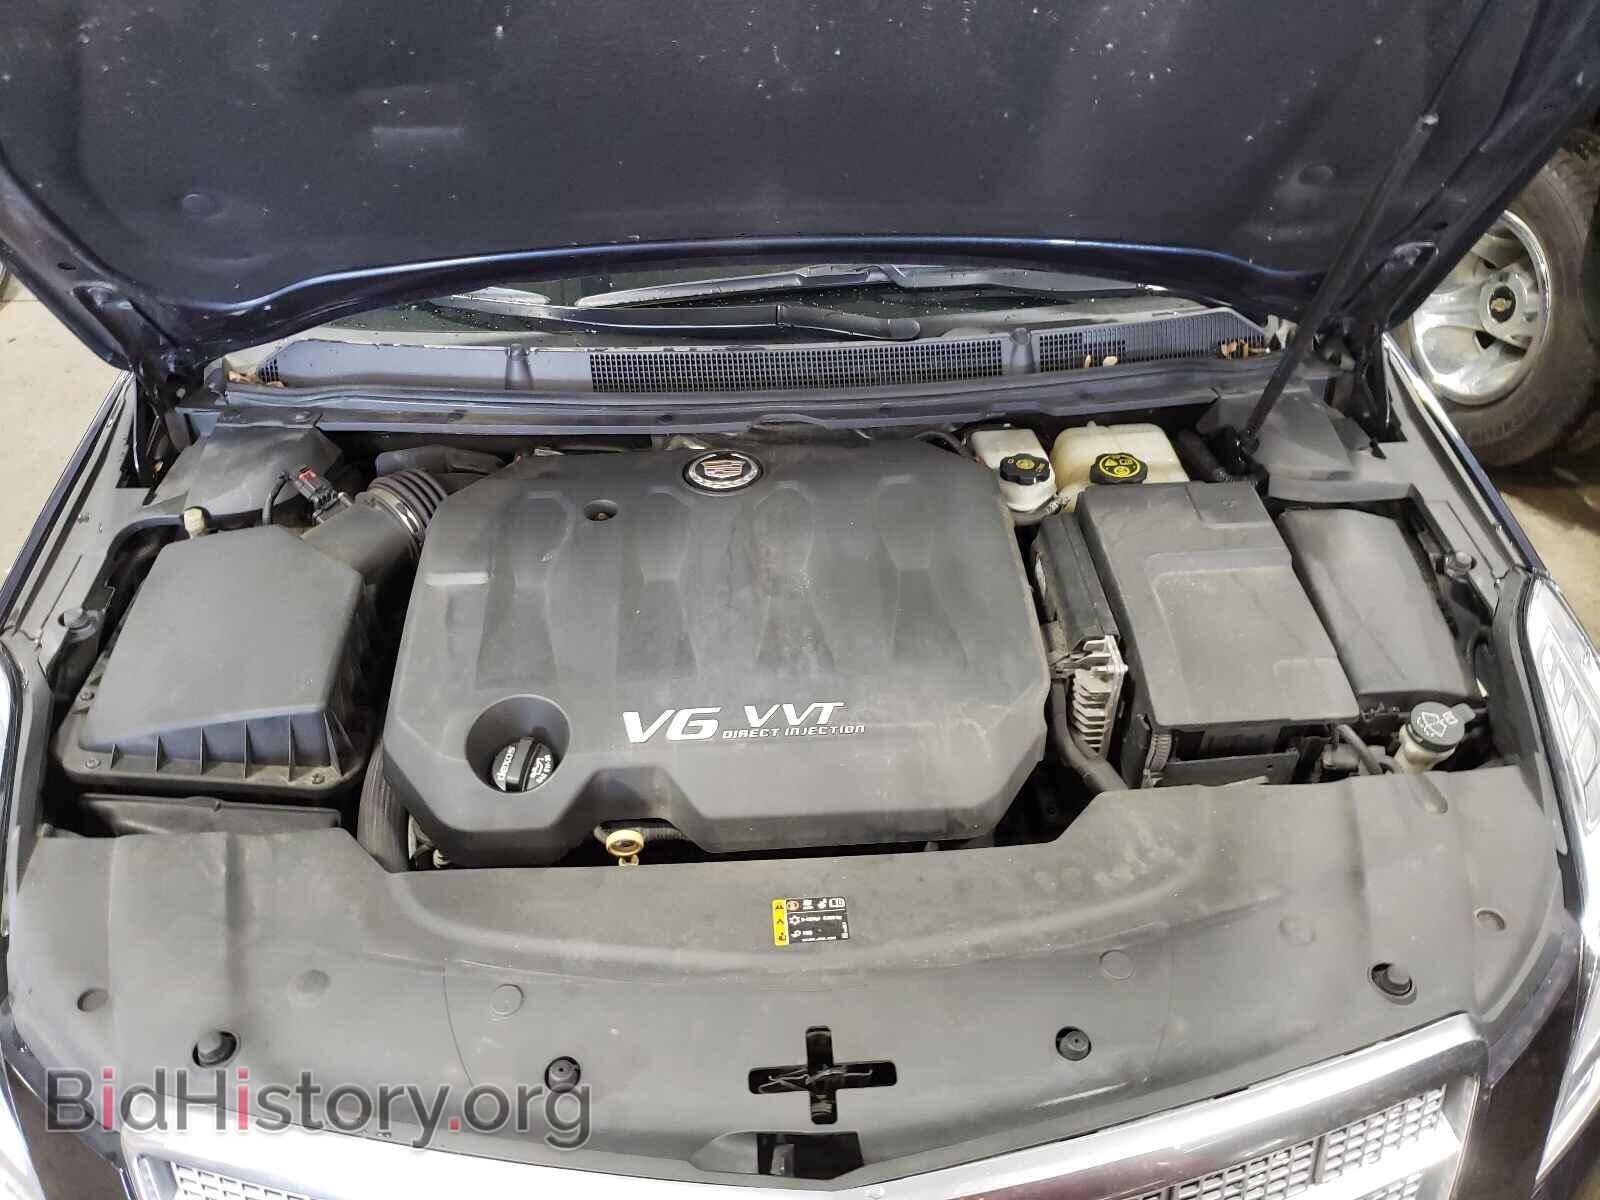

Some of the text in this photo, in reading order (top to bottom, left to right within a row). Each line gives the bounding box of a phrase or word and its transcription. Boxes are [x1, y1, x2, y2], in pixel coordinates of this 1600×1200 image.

[622, 701, 845, 744] V6 VVT
[722, 725, 866, 740] DIRECT INJECTION
